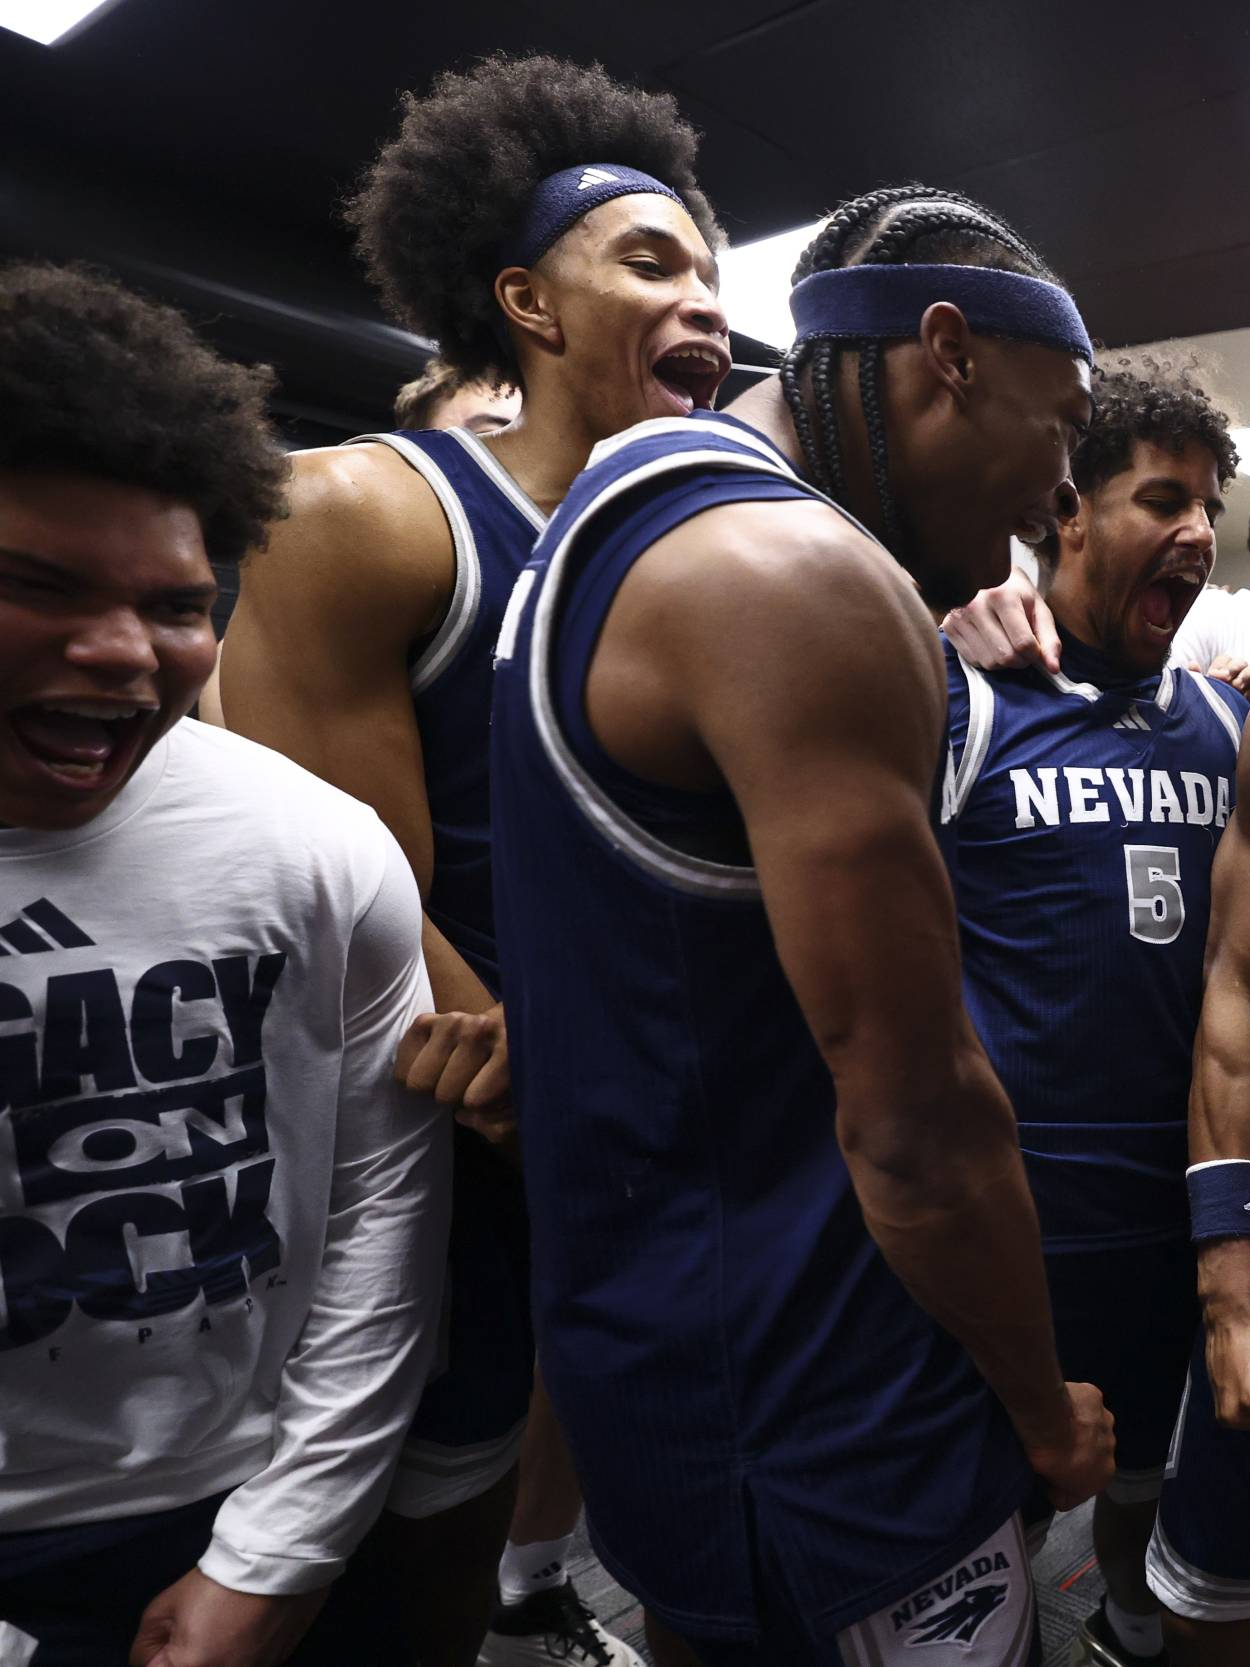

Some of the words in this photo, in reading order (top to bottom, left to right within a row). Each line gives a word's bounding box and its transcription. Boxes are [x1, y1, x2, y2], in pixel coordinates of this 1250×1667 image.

[1009, 766, 1229, 829] NEVADA
[1123, 844, 1186, 945] 5
[48, 1093, 248, 1170] ON
[890, 1551, 1010, 1632] NEVADA
